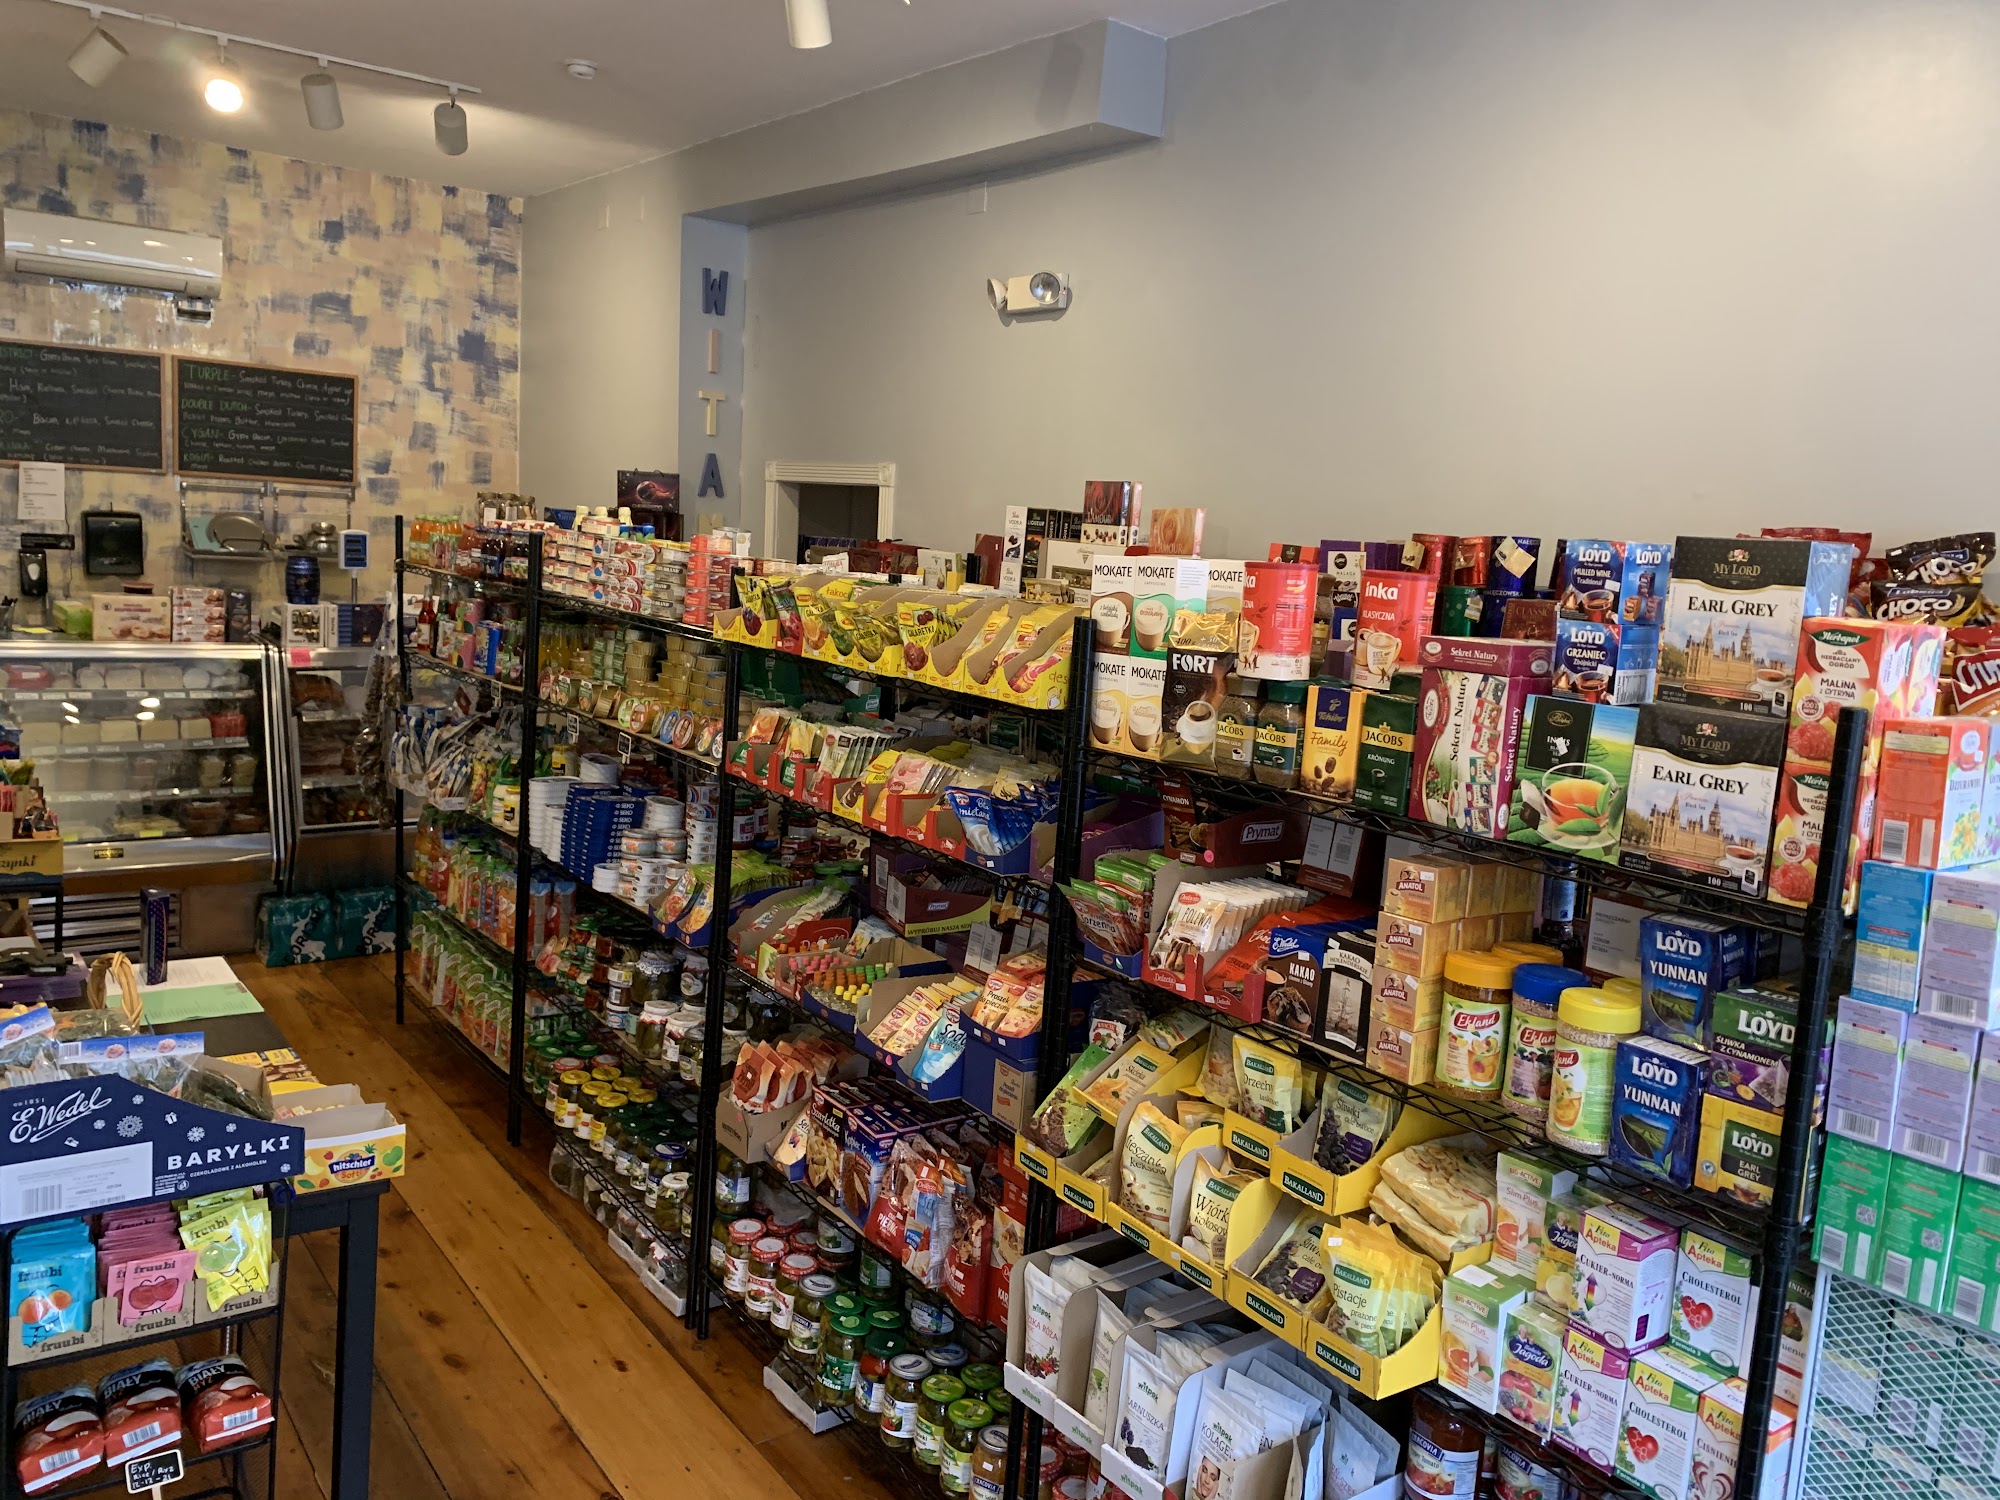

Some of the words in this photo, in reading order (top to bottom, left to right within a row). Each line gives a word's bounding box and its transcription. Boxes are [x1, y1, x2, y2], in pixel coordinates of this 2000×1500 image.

[1579, 548, 1611, 563] LOYD
[1636, 549, 1661, 564] LOYD
[1094, 564, 1132, 579] MOKATE
[1137, 565, 1175, 581] MOKATE
[1573, 567, 1595, 578] MULLED
[1596, 569, 1611, 579] WINE
[1713, 562, 1730, 574] MY
[1732, 562, 1761, 576] LORD
[1365, 581, 1402, 600] inka
[1576, 577, 1603, 586] Traditional
[1362, 610, 1395, 621] KLASYCZNA
[1688, 595, 1729, 614] EARL
[1731, 599, 1779, 619] GREY
[1876, 598, 1953, 621] CHOCO
[1570, 628, 1605, 644] LOYD
[1172, 653, 1218, 674] FORT
[1450, 647, 1472, 658] Sekret
[1473, 650, 1499, 662] Natury
[1566, 648, 1606, 661] GRZANIEC
[1093, 661, 1126, 676] MOKATE
[1131, 665, 1167, 682] MOKATE
[1828, 661, 1855, 670] OGRÓD
[1048, 671, 1069, 684] des
[1455, 675, 1470, 717] Natury
[1317, 710, 1345, 723] Tchibo
[1740, 702, 1753, 712] 100
[1216, 723, 1244, 736] JACOBS
[1256, 730, 1286, 744] JACOBS
[1366, 730, 1403, 747] JACOBS
[1311, 731, 1348, 756] Family
[1450, 721, 1462, 762] Sekret
[1504, 748, 1514, 782] Sekret
[1510, 707, 1521, 745] Natury
[1700, 737, 1731, 751] LORD
[1367, 753, 1395, 765] KRÖNUNG
[1652, 765, 1696, 786] EARL
[1699, 773, 1749, 795] GREY
[959, 807, 990, 820] mietana
[1245, 823, 1281, 840] Prymat
[1398, 881, 1423, 892] ANATOL
[1707, 876, 1722, 887] 100
[1387, 935, 1412, 946] ANATOL
[1656, 931, 1702, 957] LOYD
[1329, 956, 1368, 975] HOLENDERSKIE
[1339, 952, 1361, 964] KAKAO
[1289, 962, 1315, 981] KAKAO
[1650, 960, 1708, 986] YUNNAN
[1383, 988, 1407, 1000] ANATOL
[1456, 1012, 1496, 1028] Ekland
[1738, 1009, 1796, 1043] LOYD
[1378, 1042, 1401, 1053] ANATOL
[1715, 1034, 1745, 1051] ŚLIWKA
[1245, 1058, 1274, 1075] BAKALLAND
[1727, 1047, 1779, 1068] CYNAMONEM
[1631, 1056, 1678, 1087] LOYD
[1340, 1082, 1368, 1101] BAKALLAND
[1623, 1084, 1681, 1117] YUNNAN
[1143, 1126, 1171, 1152] BAKALLAND
[1231, 1132, 1269, 1158] BAKALLAND
[1732, 1130, 1773, 1159] LOYD
[168, 1135, 290, 1171] BARYŁKI
[190, 1165, 230, 1178] CZEKOLADOWE
[235, 1159, 267, 1170] ALKOHOLEM
[332, 1159, 372, 1172] hitschler
[1019, 1152, 1048, 1179] BAKALLAND
[1737, 1168, 1761, 1182] GREY
[1739, 1160, 1761, 1174] EARL
[1508, 1166, 1541, 1186] BIO-ACTIVE
[1283, 1173, 1324, 1203] BAKALLAND
[1505, 1186, 1522, 1199] Slim
[1522, 1191, 1539, 1206] Plus
[1063, 1185, 1094, 1211] BAKALLAND
[1196, 1193, 1229, 1222] Wiórk
[1121, 1223, 1149, 1248] BAKALLAND
[1585, 1229, 1617, 1252] Apteka
[1594, 1224, 1610, 1239] Fito
[1697, 1240, 1715, 1255] Fito
[134, 1260, 176, 1274] fruubi
[1687, 1246, 1722, 1269] Apteka
[17, 1265, 62, 1282] fruubi
[1181, 1261, 1211, 1289] BAKALLAND
[1334, 1265, 1371, 1287] BAKALLAND
[1580, 1253, 1634, 1289] CUKIER-NORMA
[1333, 1282, 1367, 1308] Pistacje
[1682, 1271, 1742, 1306] CHOLESTEROL
[223, 1295, 263, 1313] fruubi
[1032, 1303, 1052, 1319] witpak
[1246, 1295, 1284, 1328] BAKALLAND
[1455, 1294, 1487, 1315] BIO-ACTIVE
[134, 1315, 176, 1333] fruubi
[1453, 1314, 1469, 1329] Slim
[1470, 1320, 1486, 1336] Plus
[40, 1334, 85, 1354] fruubi
[1578, 1340, 1595, 1355] Fito
[1316, 1344, 1360, 1380] BAKALLAND
[1512, 1342, 1549, 1367] Jagoda
[1569, 1344, 1601, 1369] Apteka
[188, 1364, 225, 1385] BIAŁY
[1645, 1372, 1664, 1387] Fito
[104, 1373, 142, 1399] BIAŁY
[1137, 1381, 1159, 1402] witpak
[1563, 1370, 1618, 1407] CUKIER-NORMA
[1635, 1376, 1670, 1402] Apteka
[1021, 1387, 1042, 1406] witpak
[22, 1400, 62, 1426] BIAŁY
[1629, 1401, 1688, 1441] CHOLESTEROL
[1716, 1410, 1735, 1426] Fito
[1071, 1425, 1093, 1444] witpak
[1202, 1422, 1234, 1458] KOLAGE
[1213, 1421, 1232, 1443] witpak
[1120, 1474, 1144, 1495] witpak
